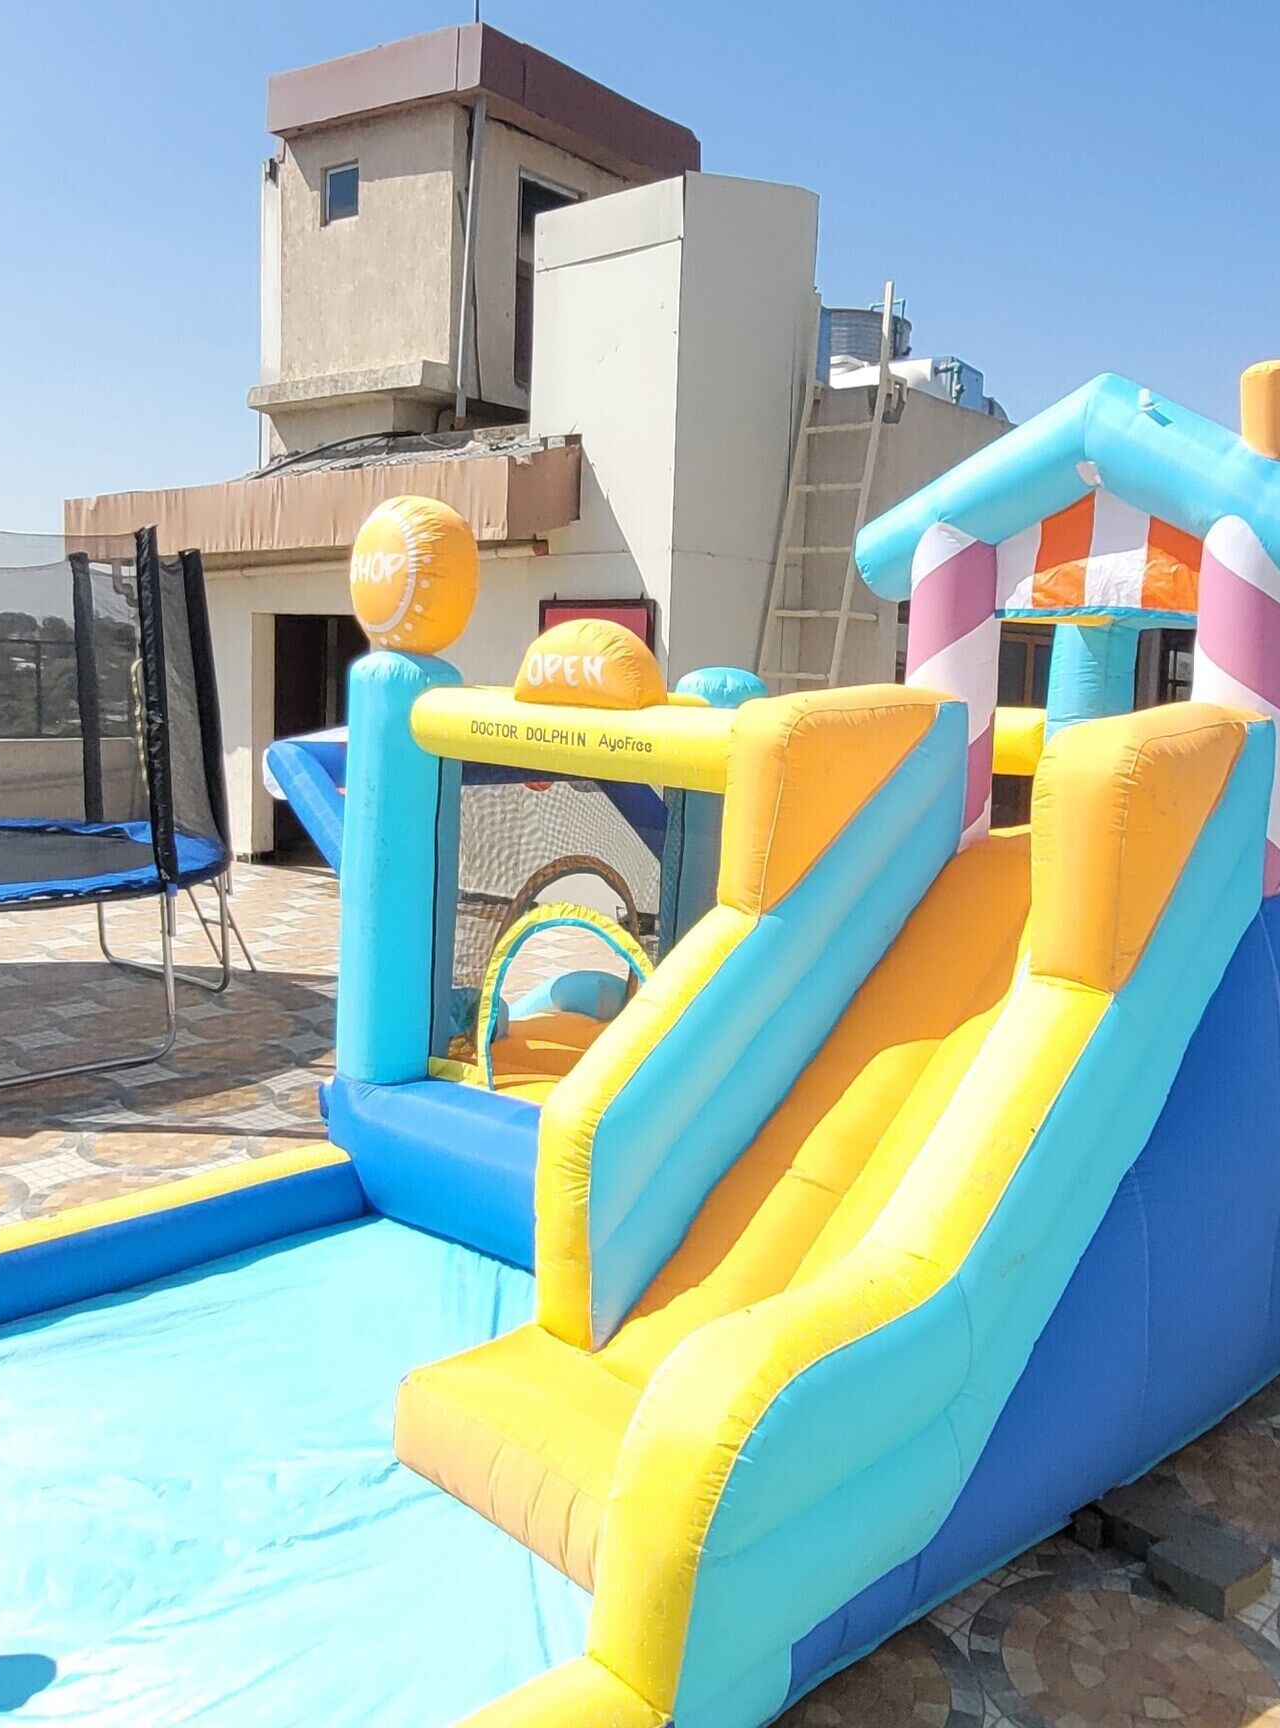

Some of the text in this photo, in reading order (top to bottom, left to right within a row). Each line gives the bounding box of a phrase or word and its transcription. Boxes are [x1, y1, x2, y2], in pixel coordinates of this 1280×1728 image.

[526, 652, 606, 687] OPEN
[471, 720, 653, 753] DOCTOR DOLPHIN AyoFree
